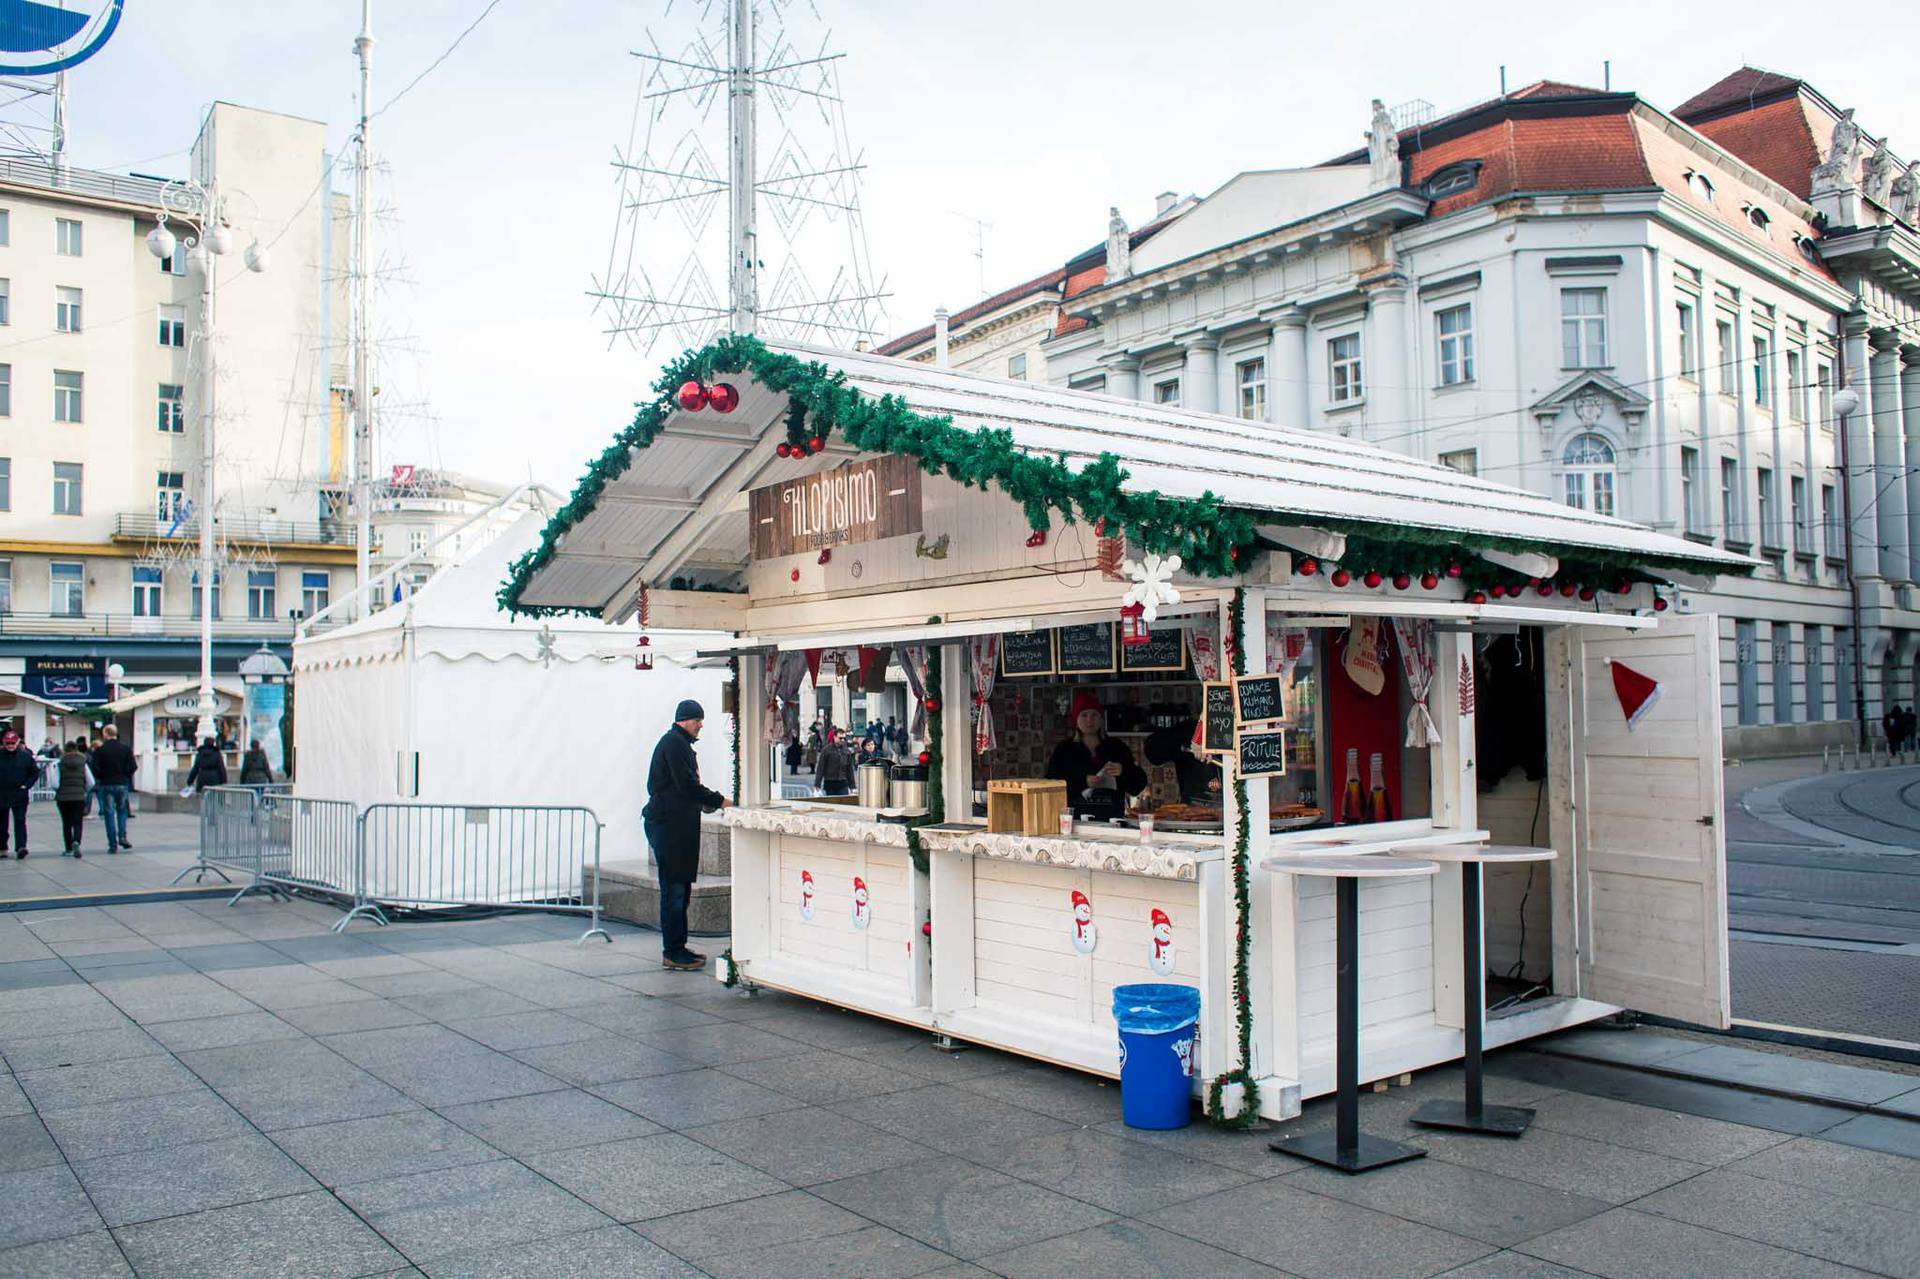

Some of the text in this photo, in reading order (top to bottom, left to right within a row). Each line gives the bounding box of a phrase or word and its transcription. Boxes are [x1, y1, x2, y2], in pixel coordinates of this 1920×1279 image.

[783, 469, 877, 537] KLOPISIMO
[1208, 689, 1230, 701] SENF
[1240, 739, 1281, 759] FRITULE
